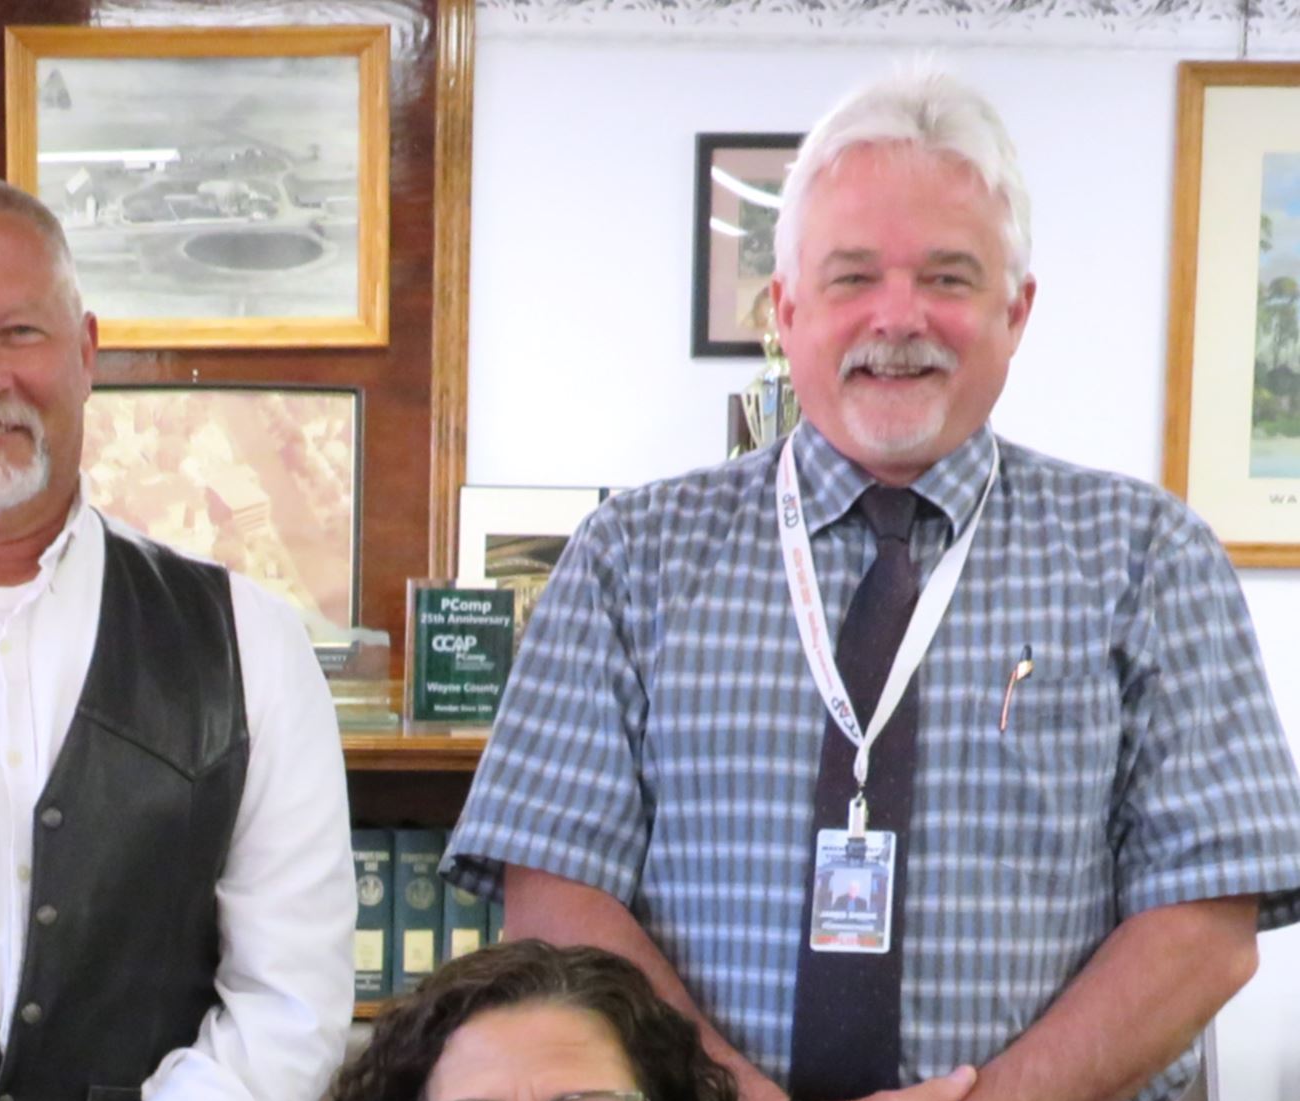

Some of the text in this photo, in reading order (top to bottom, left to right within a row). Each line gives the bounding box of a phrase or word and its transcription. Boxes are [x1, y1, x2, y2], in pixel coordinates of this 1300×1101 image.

[441, 597, 492, 615] PComp
[420, 612, 511, 627] 25th Anniversary
[432, 634, 477, 652] CCAP
[426, 682, 500, 696] Wayne County
